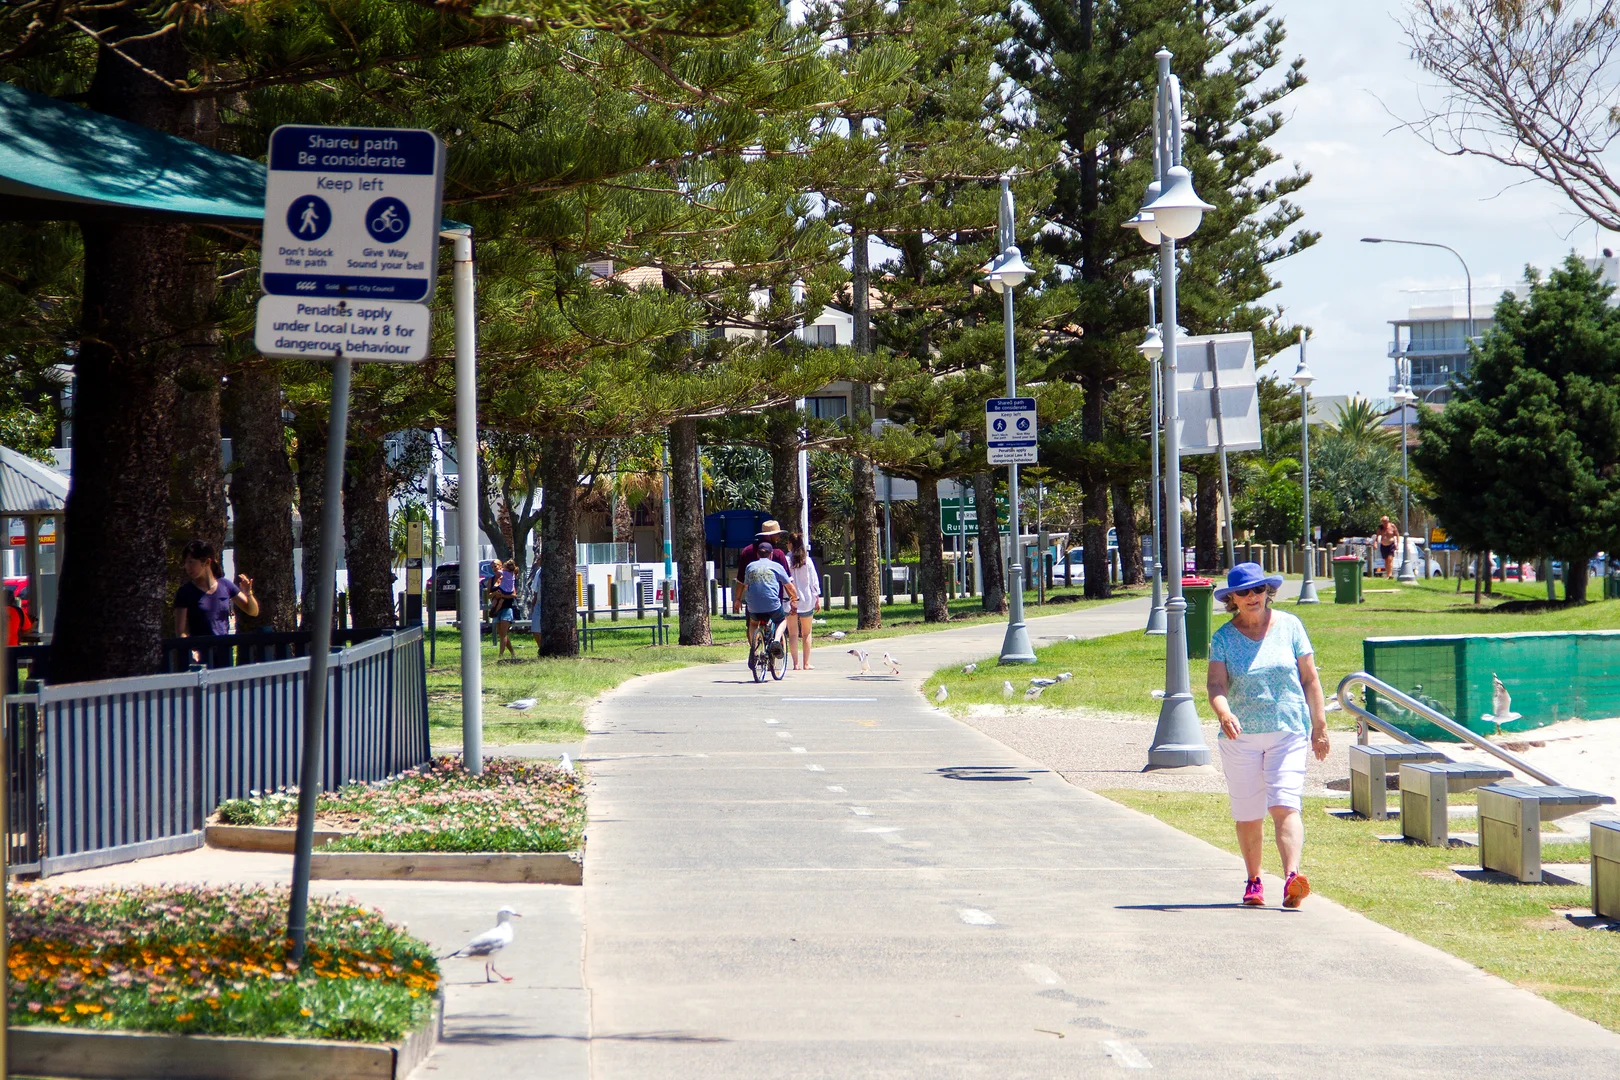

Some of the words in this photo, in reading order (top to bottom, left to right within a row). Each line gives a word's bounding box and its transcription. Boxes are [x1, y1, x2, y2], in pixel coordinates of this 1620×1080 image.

[308, 134, 359, 149] Shared
[364, 137, 398, 152] path
[298, 151, 316, 165] Be
[321, 153, 406, 168] considerate
[316, 177, 353, 193] Keep
[358, 177, 384, 191] left
[279, 247, 305, 256] Don't
[308, 247, 333, 257] block
[362, 248, 384, 258] Give
[387, 249, 409, 260] Way
[285, 258, 301, 266] the
[304, 258, 328, 269] path
[347, 259, 377, 269] Sound
[380, 261, 403, 271] your
[406, 261, 424, 270] bell
[297, 303, 352, 317] Penalties
[357, 307, 392, 321] apply
[273, 321, 310, 332] under
[314, 322, 347, 334] Local
[350, 323, 377, 335] Law
[382, 324, 390, 336] 8
[395, 325, 415, 337] for
[275, 336, 341, 352] dangerous
[346, 340, 411, 354] behaviour
